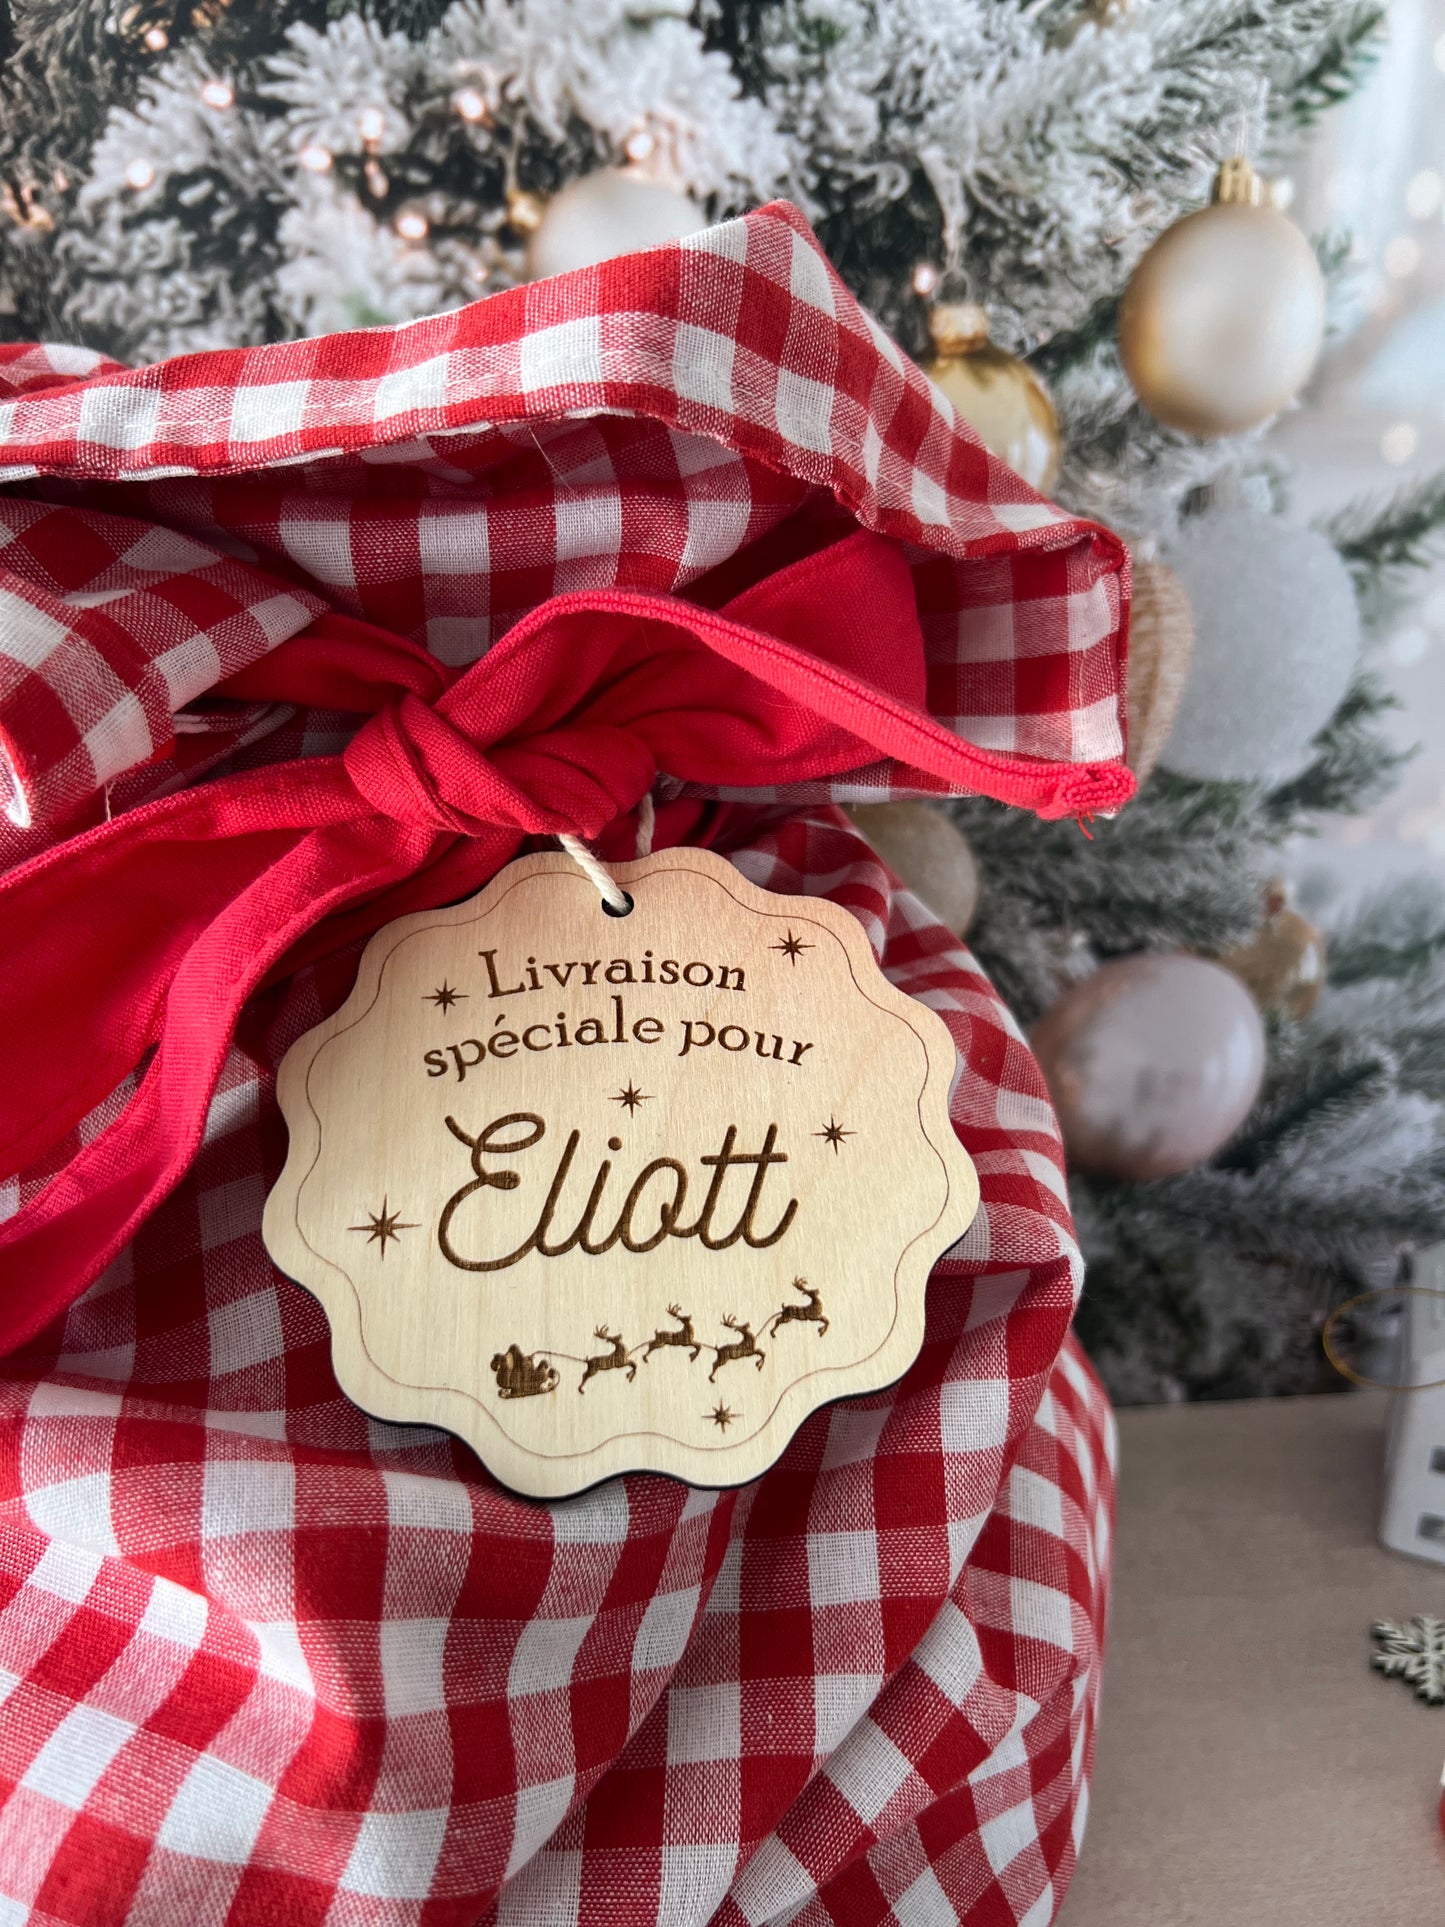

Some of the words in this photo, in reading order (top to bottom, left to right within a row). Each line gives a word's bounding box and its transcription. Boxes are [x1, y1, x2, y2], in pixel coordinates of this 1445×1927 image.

[477, 948, 747, 998] Livraison
[423, 995, 666, 1083] spéciale
[677, 1011, 814, 1067] pour
[437, 1112, 799, 1272] Eliott
